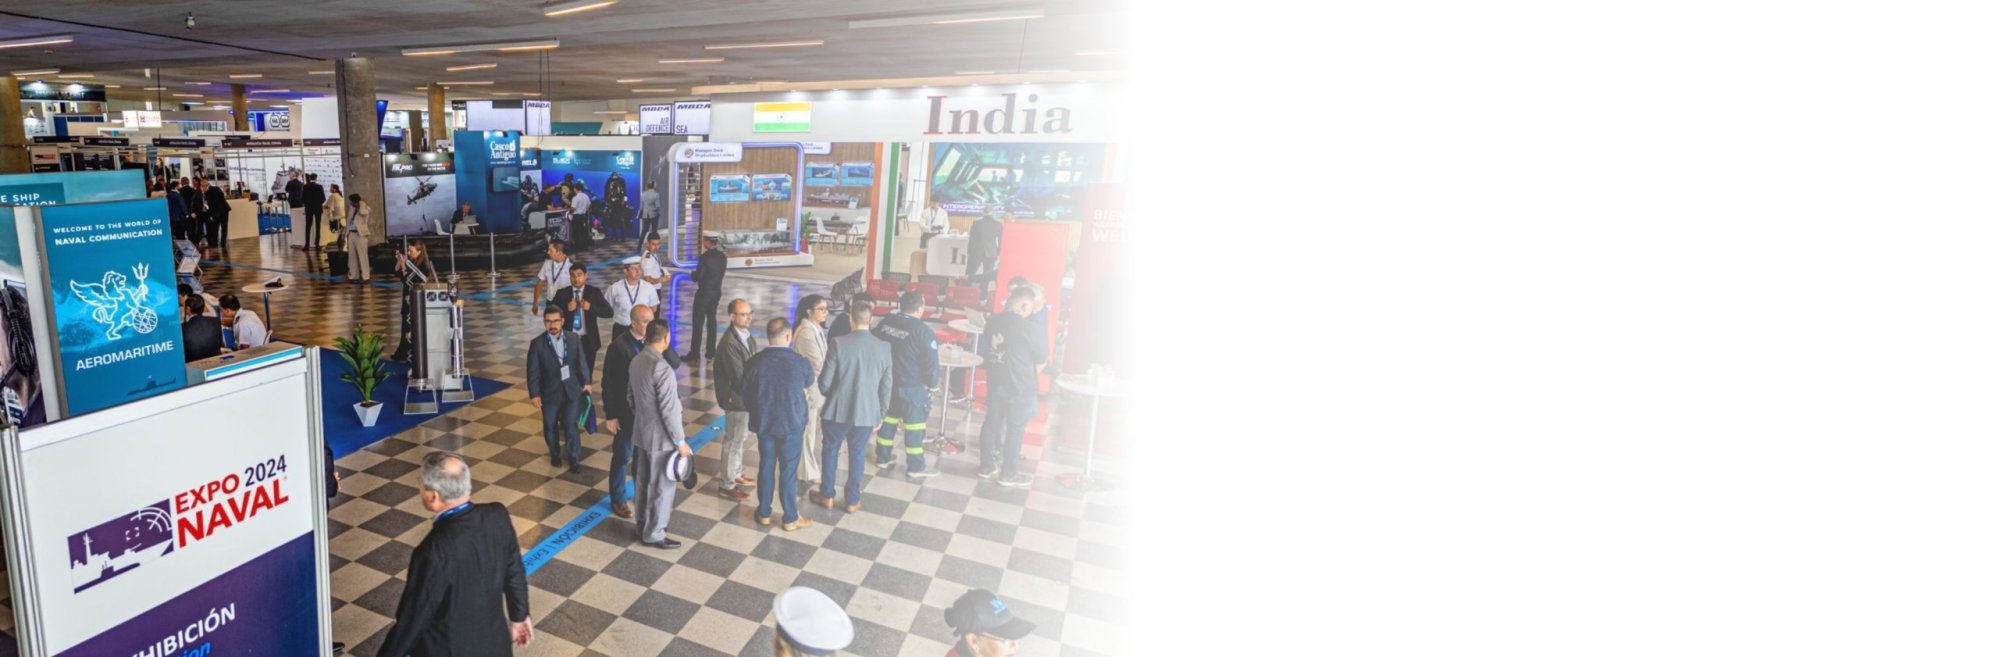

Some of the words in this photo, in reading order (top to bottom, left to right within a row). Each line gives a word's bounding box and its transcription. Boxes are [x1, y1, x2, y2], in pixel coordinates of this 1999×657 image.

[660, 117, 669, 125] AIR
[923, 93, 1073, 135] India
[646, 124, 668, 132] DEFENCE
[676, 124, 688, 134] SEA
[12, 193, 40, 202] SHIP
[53, 225, 93, 234] WELCOME
[124, 220, 151, 228] WORLD
[54, 235, 87, 246] NAVAL
[89, 229, 163, 244] COMMUNICATION
[75, 340, 174, 371] AEROMARITIME
[174, 473, 240, 515] EXPO
[244, 454, 288, 488] 2024
[176, 478, 289, 548] NAVAL
[131, 602, 236, 657] HIBICIÓN
